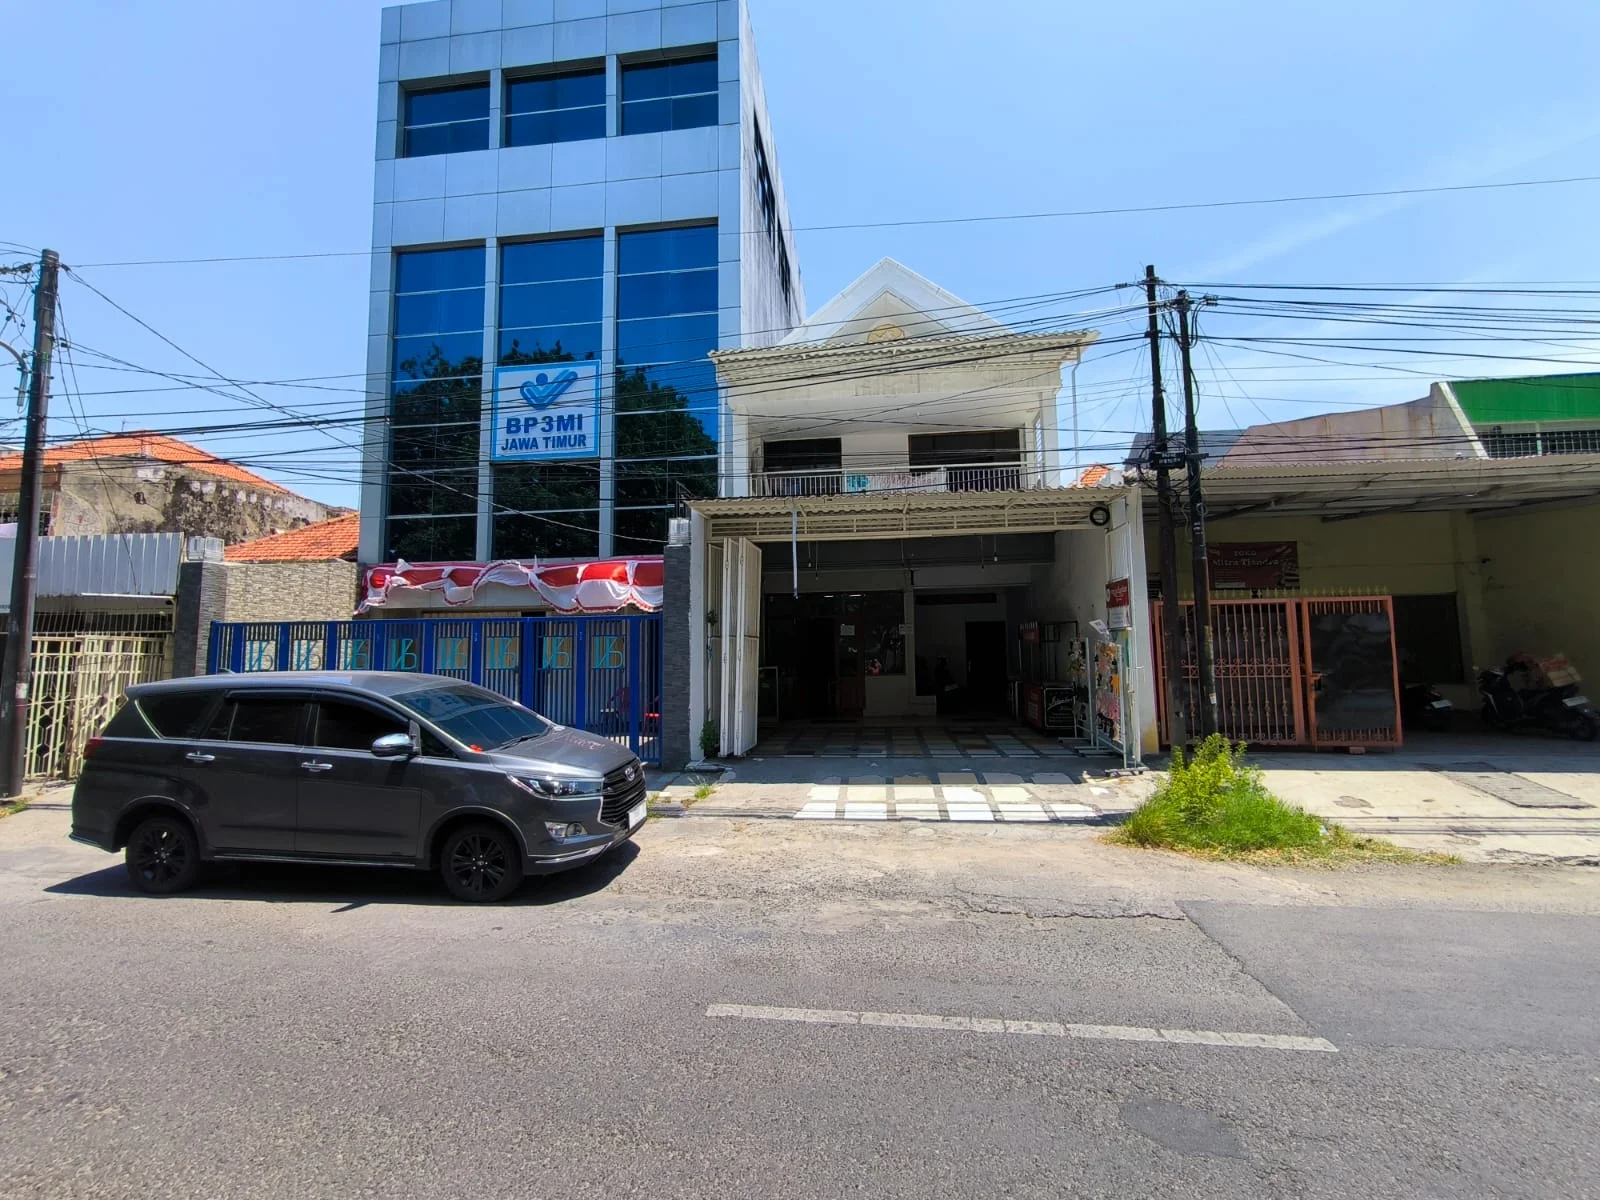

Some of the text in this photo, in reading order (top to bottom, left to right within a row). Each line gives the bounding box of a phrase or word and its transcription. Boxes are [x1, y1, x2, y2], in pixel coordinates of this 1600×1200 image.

[506, 414, 583, 434] BP3MI
[501, 434, 586, 451] JAWA TIMUR
